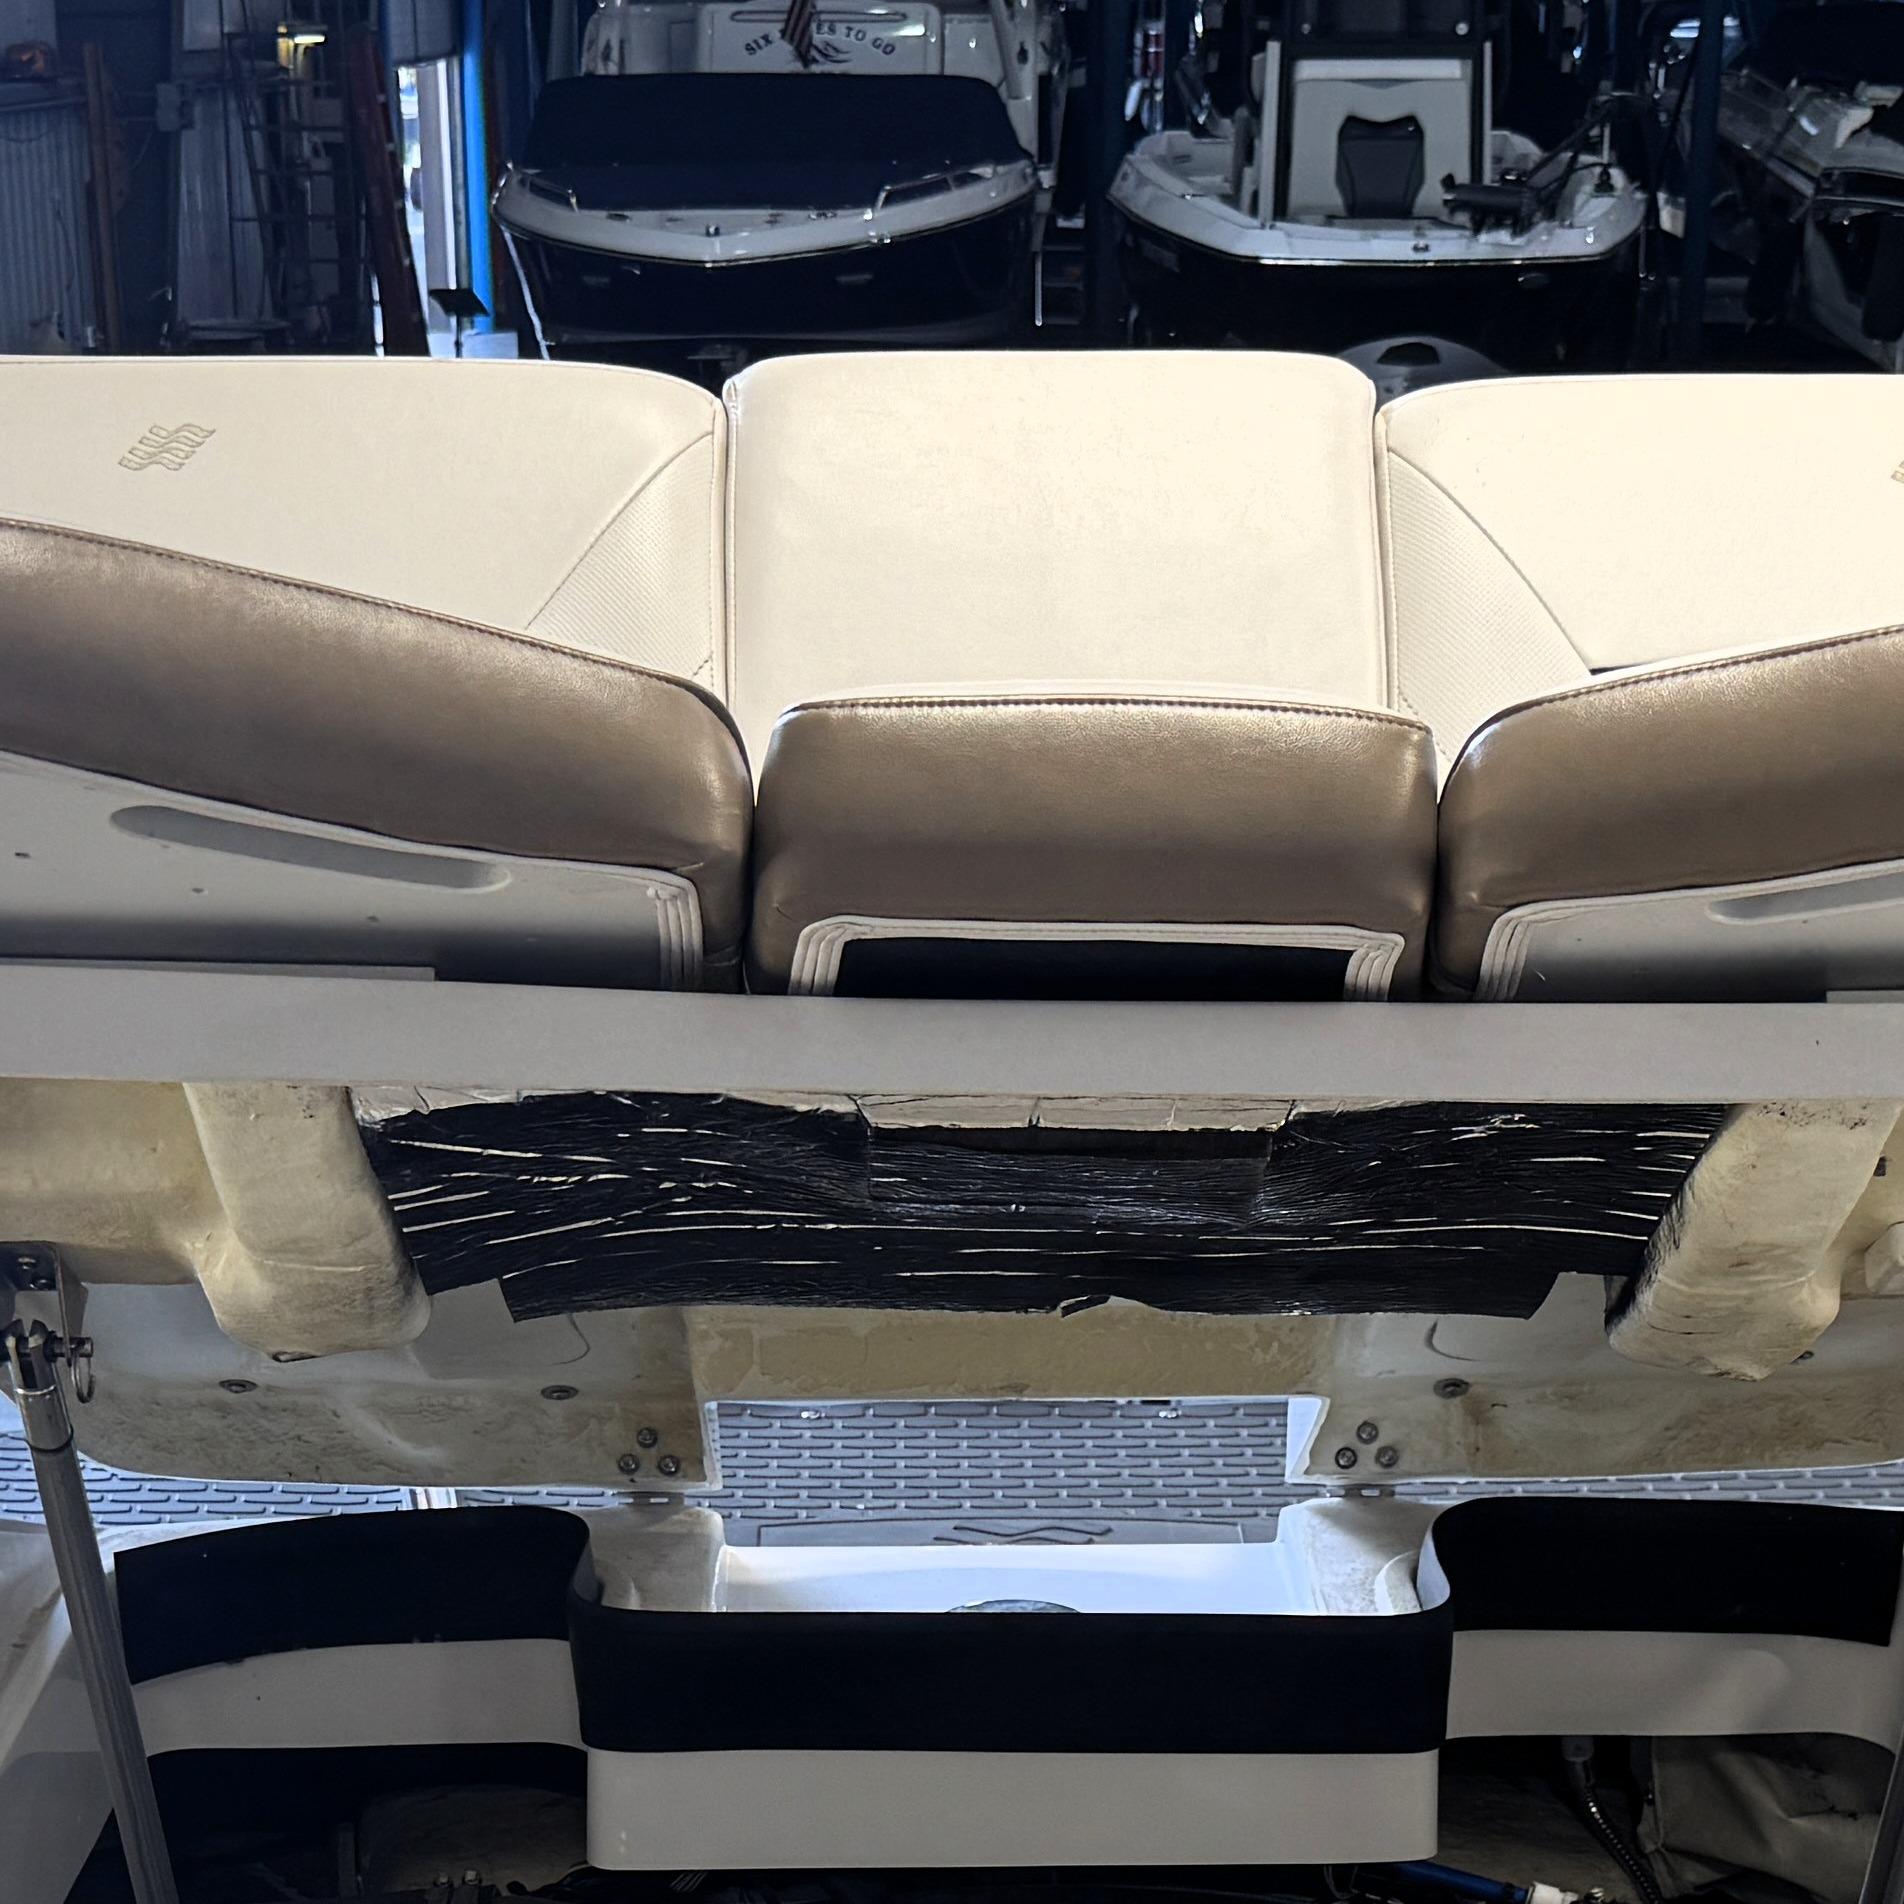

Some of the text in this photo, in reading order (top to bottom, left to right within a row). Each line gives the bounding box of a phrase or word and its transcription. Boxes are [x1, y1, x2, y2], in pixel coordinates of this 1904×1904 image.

[745, 33, 773, 56] SIX
[845, 26, 867, 42] TO
[871, 37, 896, 56] GO
